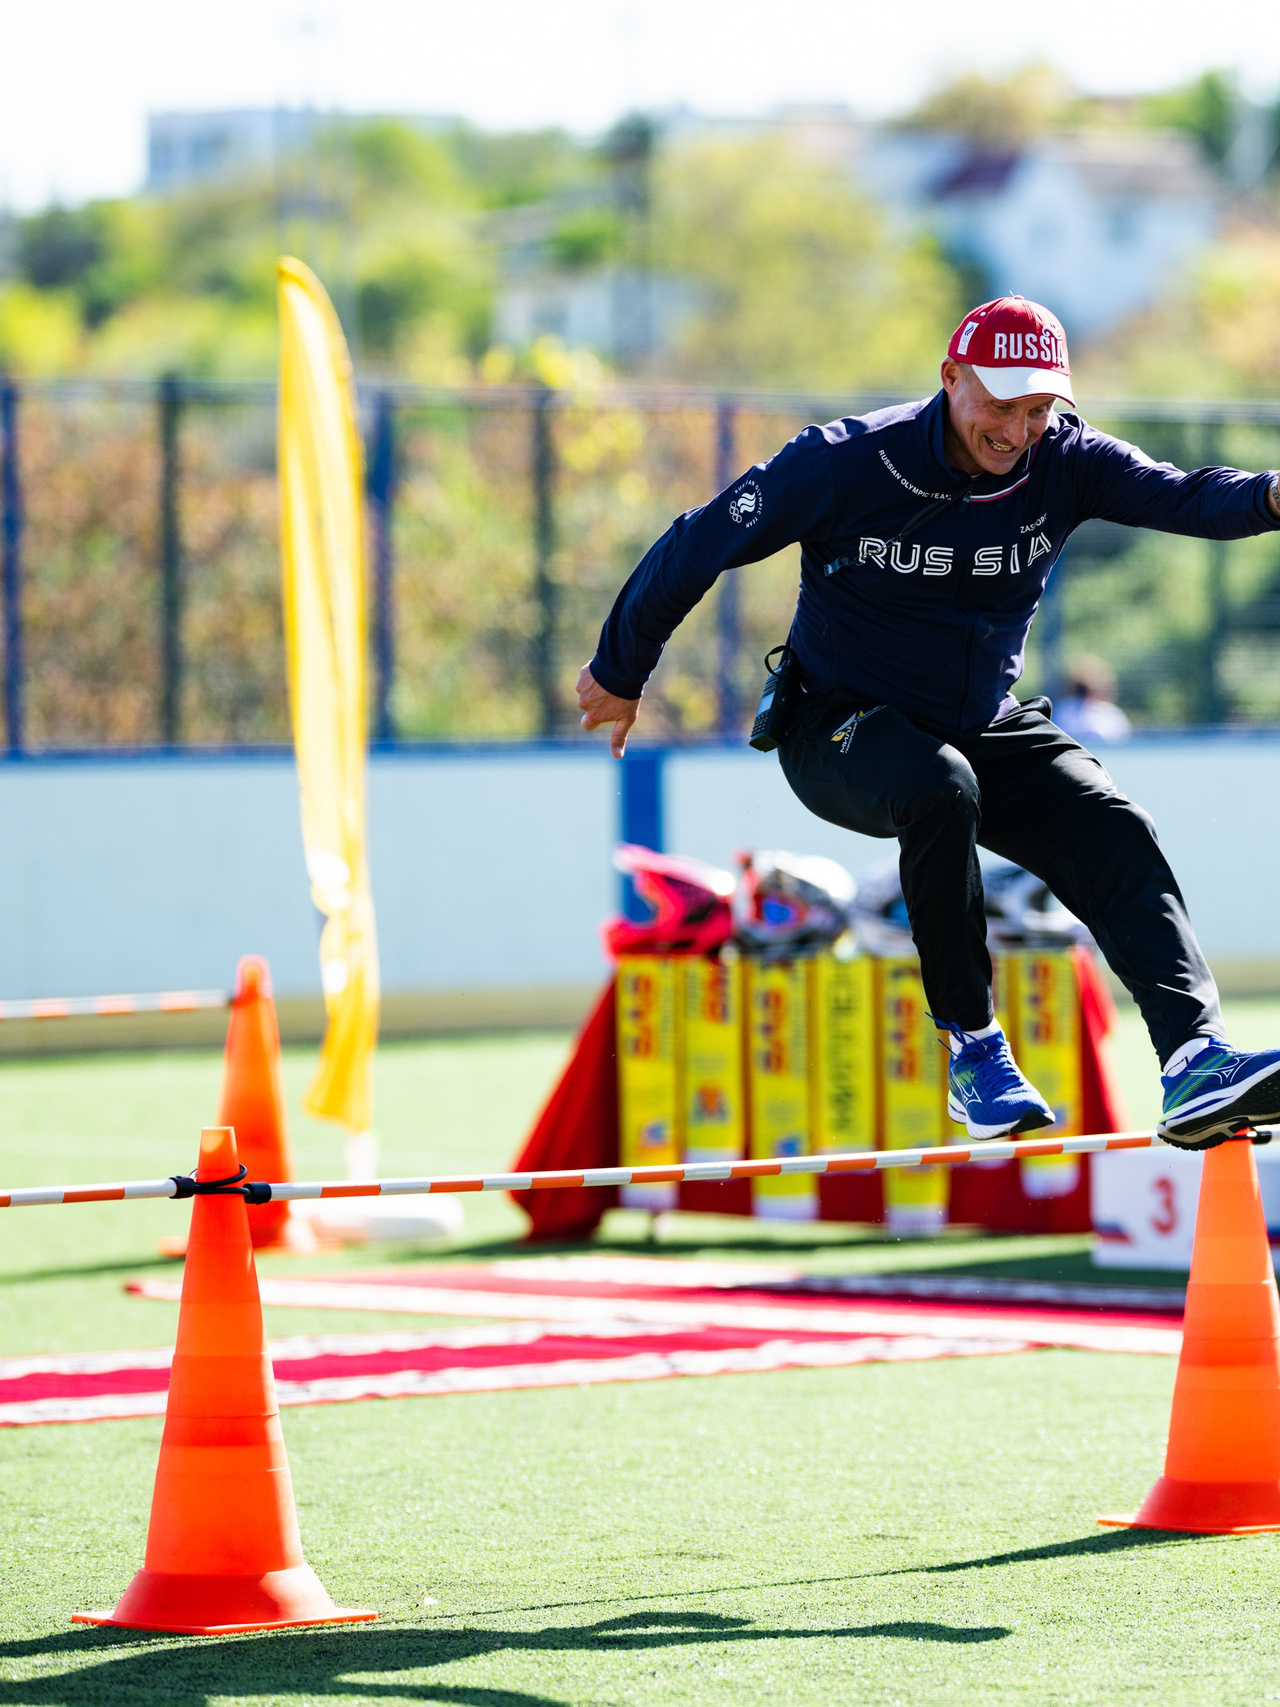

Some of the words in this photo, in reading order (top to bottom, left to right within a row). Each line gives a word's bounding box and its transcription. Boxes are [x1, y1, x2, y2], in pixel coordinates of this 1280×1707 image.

[994, 332, 1065, 368] RUSSIA
[878, 449, 902, 480] RUSSIAN
[900, 478, 930, 498] OLYMPIC
[1151, 1175, 1179, 1237] 3
